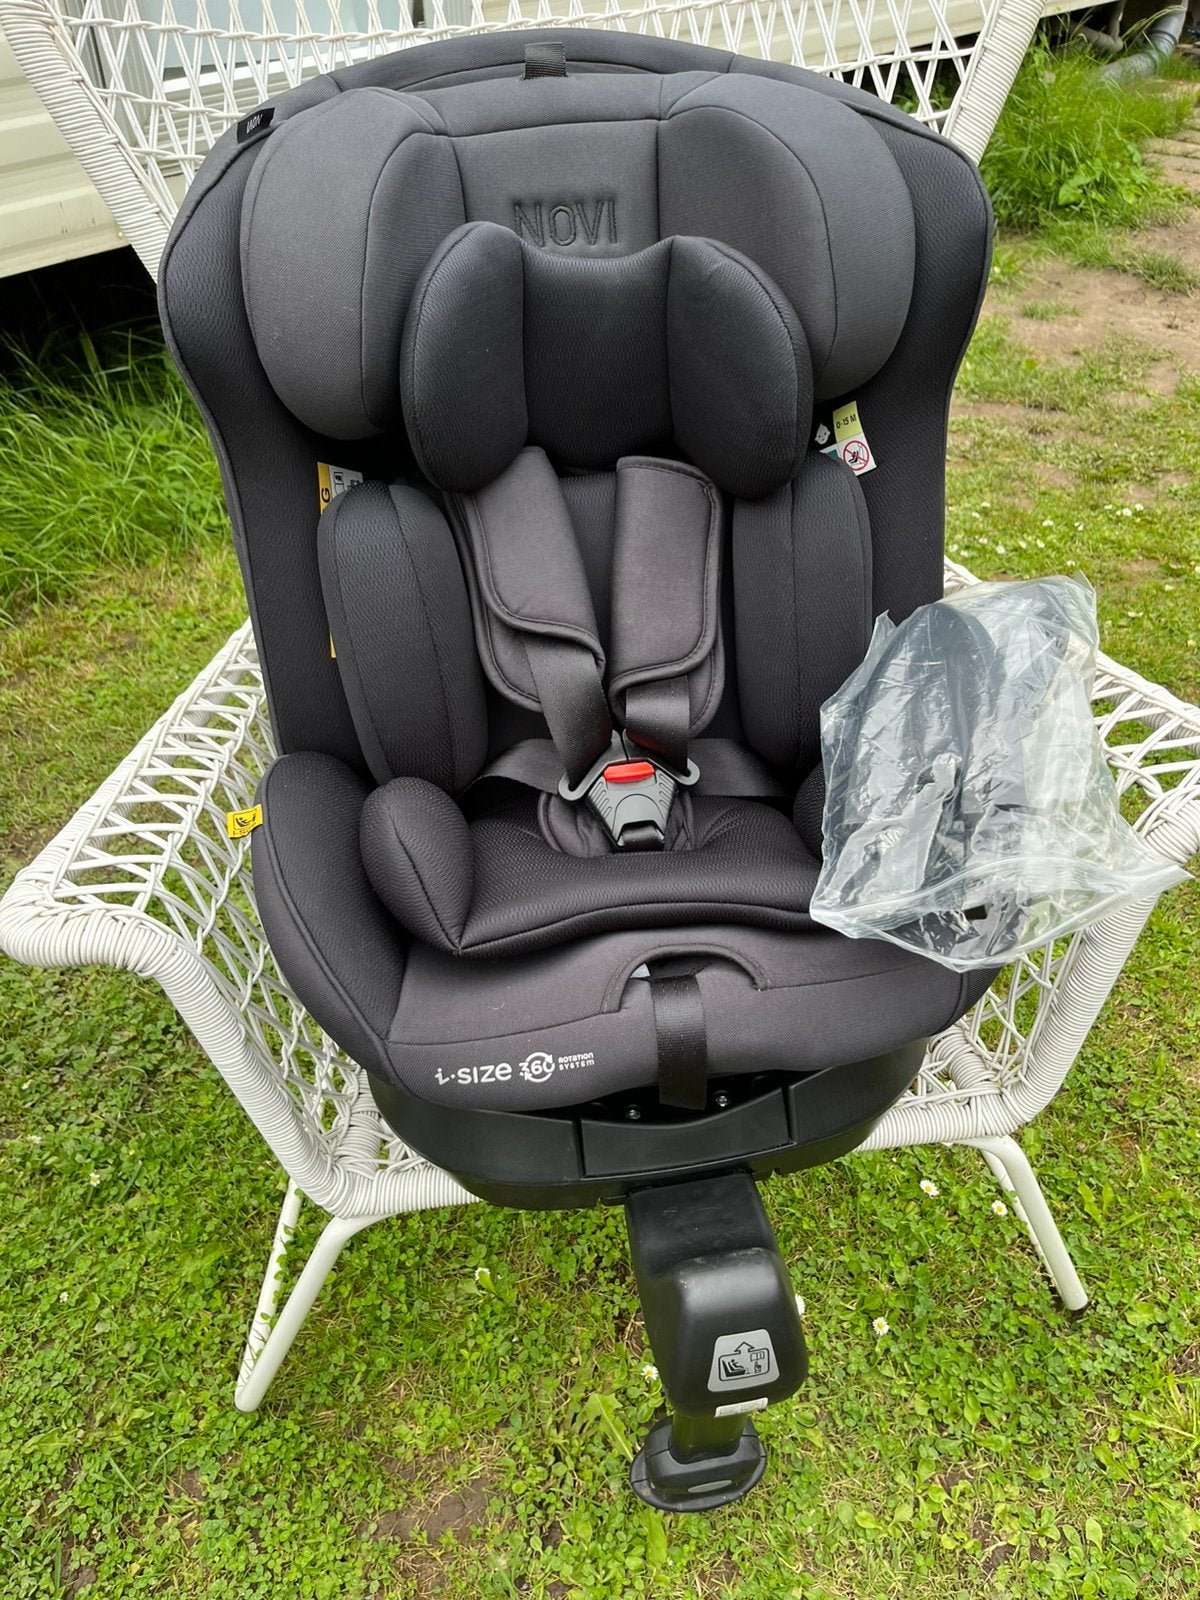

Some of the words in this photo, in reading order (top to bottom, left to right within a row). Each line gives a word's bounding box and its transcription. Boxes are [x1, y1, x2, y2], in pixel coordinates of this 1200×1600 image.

[514, 200, 617, 247] NOVI
[836, 416, 850, 429] 0-15
[850, 414, 857, 423] M
[519, 1057, 555, 1077] 360
